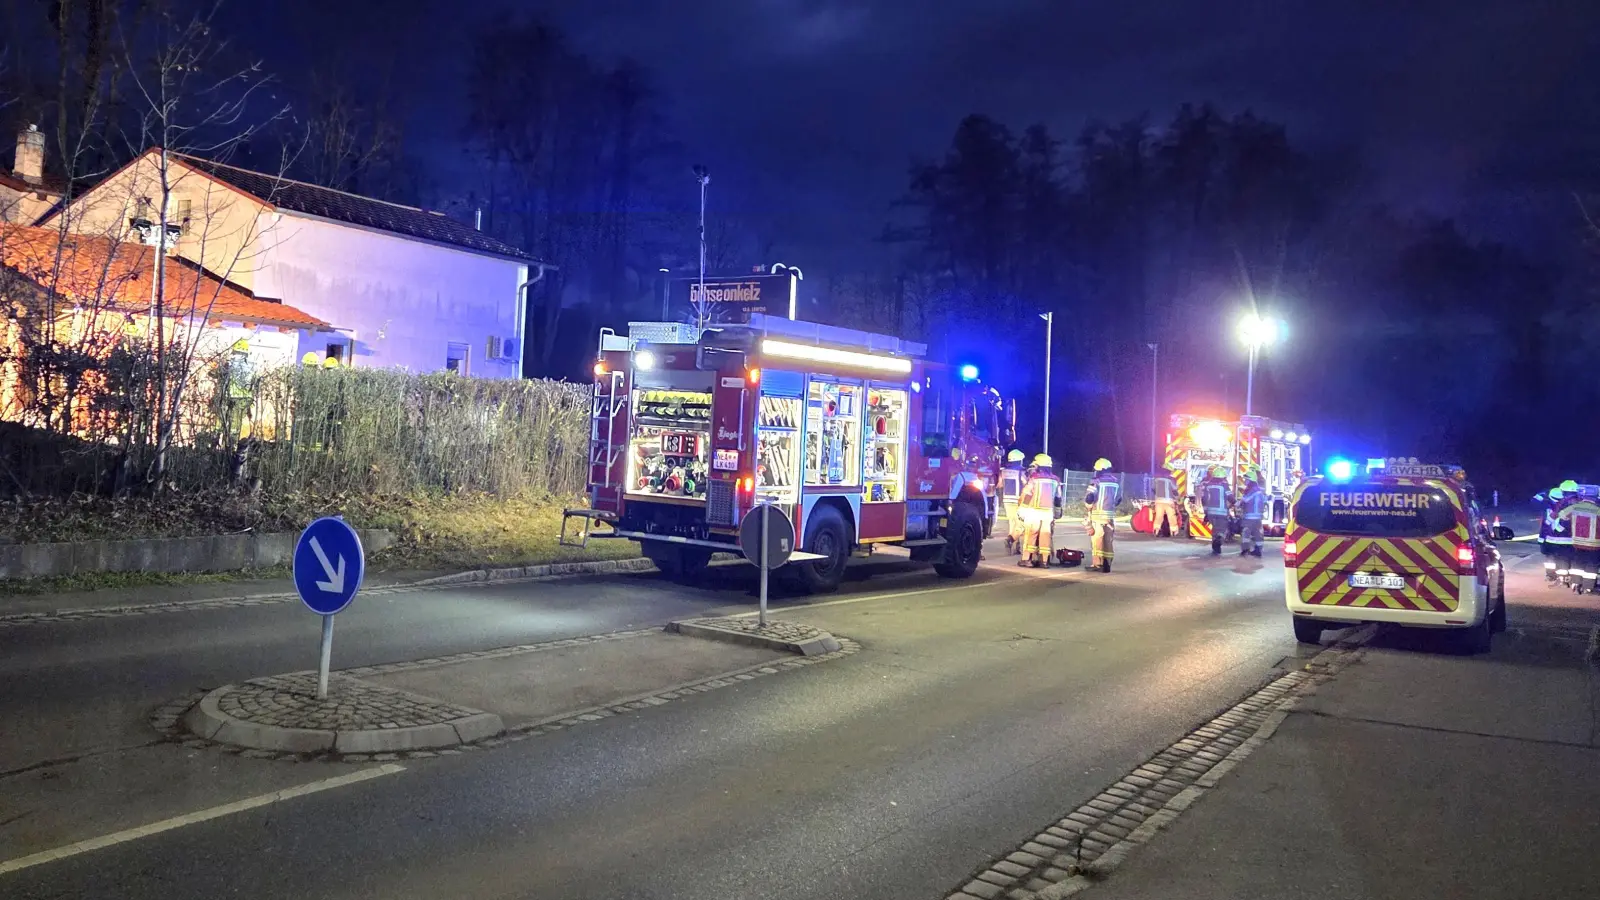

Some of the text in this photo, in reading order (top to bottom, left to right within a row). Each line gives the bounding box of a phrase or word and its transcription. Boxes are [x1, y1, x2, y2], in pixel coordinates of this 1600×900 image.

[1320, 492, 1430, 508] FEUERWEHR
[1331, 508, 1417, 517] www.feuerwehr-nea.de
[1354, 576, 1404, 587] NEA LF 101
